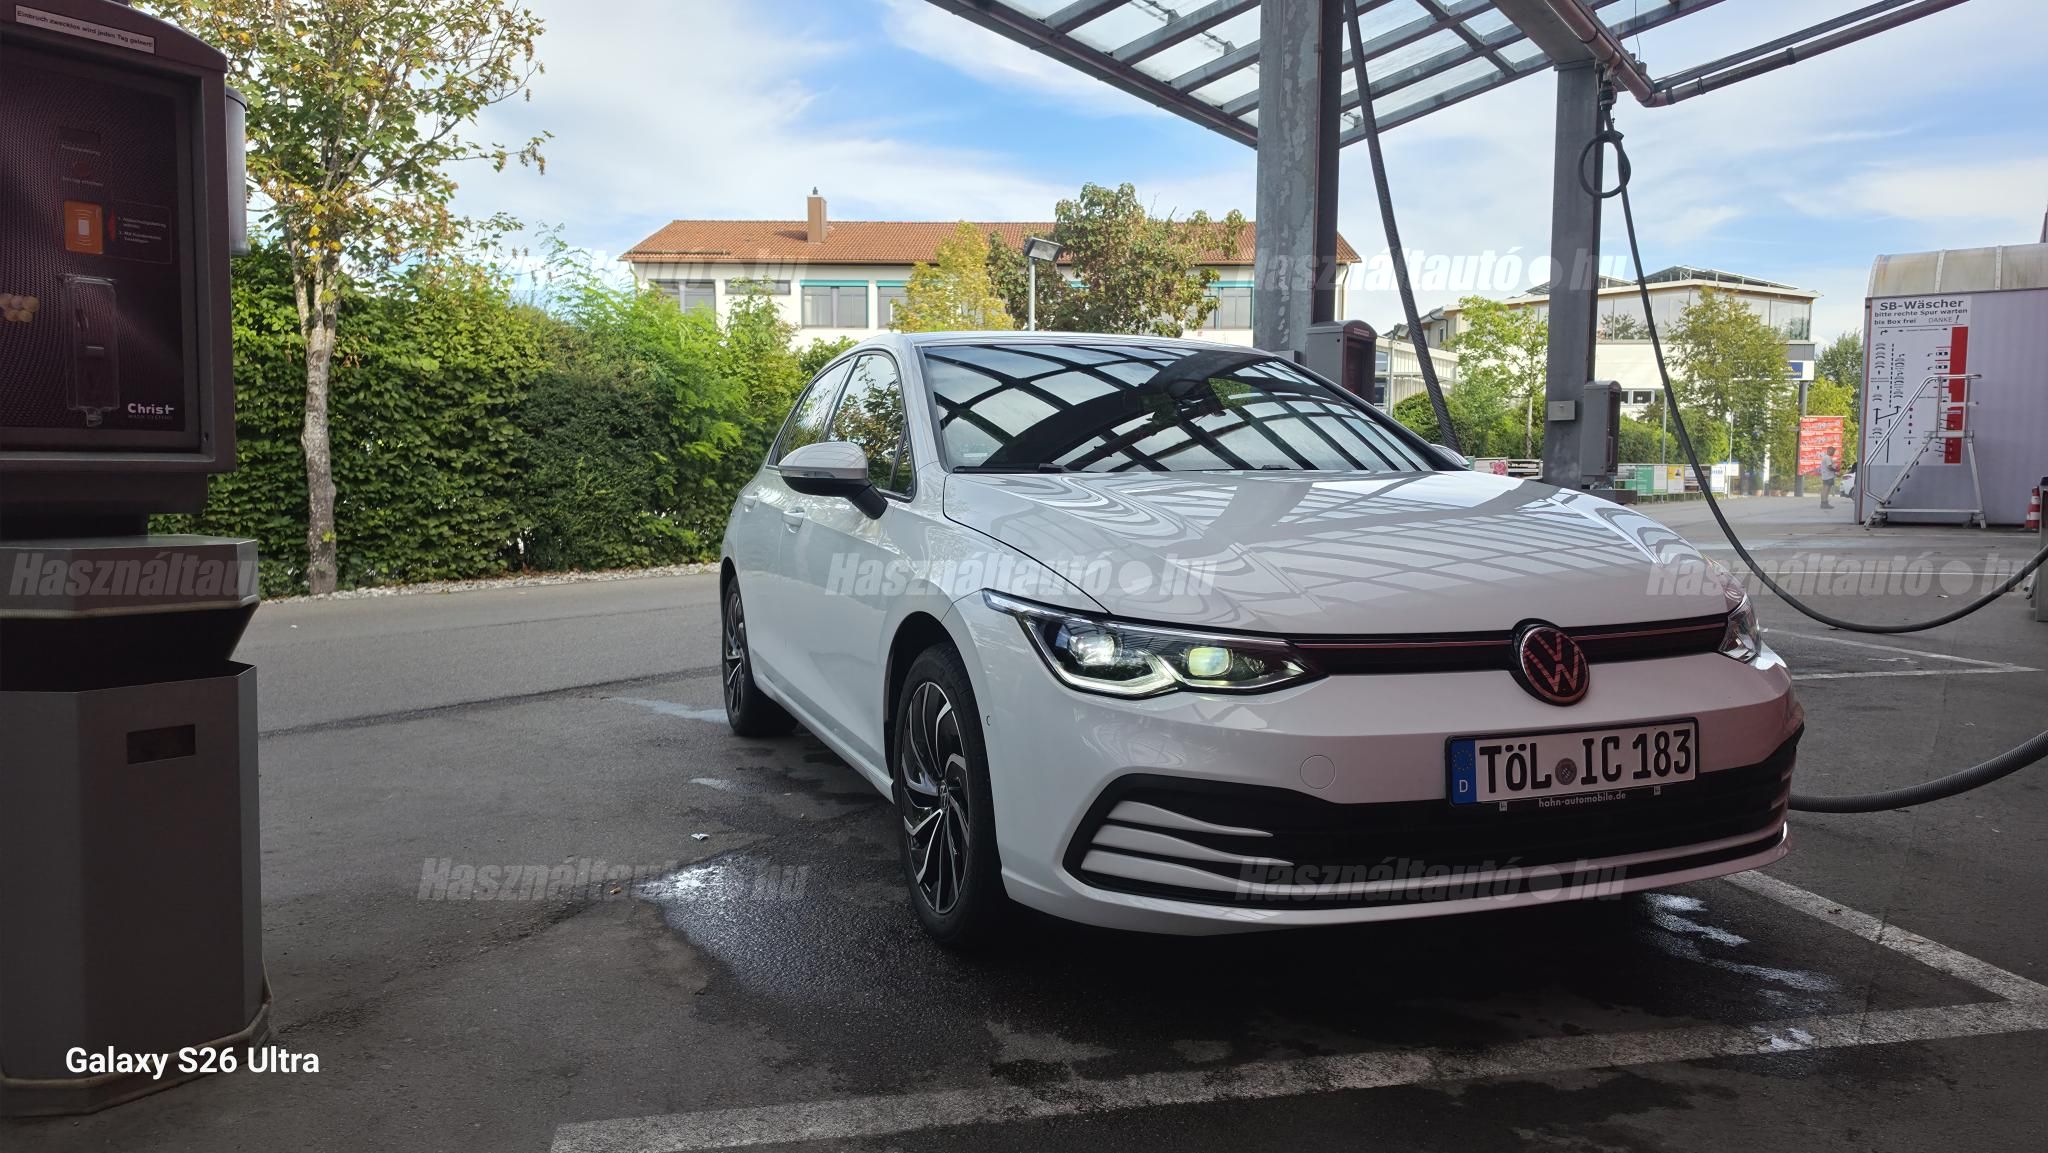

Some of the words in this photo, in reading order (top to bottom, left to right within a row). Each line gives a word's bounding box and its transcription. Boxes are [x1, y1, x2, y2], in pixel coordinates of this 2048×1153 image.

[17, 10, 49, 23] Einbruch
[82, 27, 97, 35] wird
[118, 34, 129, 43] Tag
[1880, 299, 1964, 311] SB-Wäscher
[127, 402, 175, 415] Christ
[1479, 743, 1551, 793] TÖL
[1580, 736, 1622, 786] IC
[1632, 729, 1691, 780] 183
[1459, 779, 1468, 793] D
[1538, 792, 1627, 808] hahn-automobile.de
